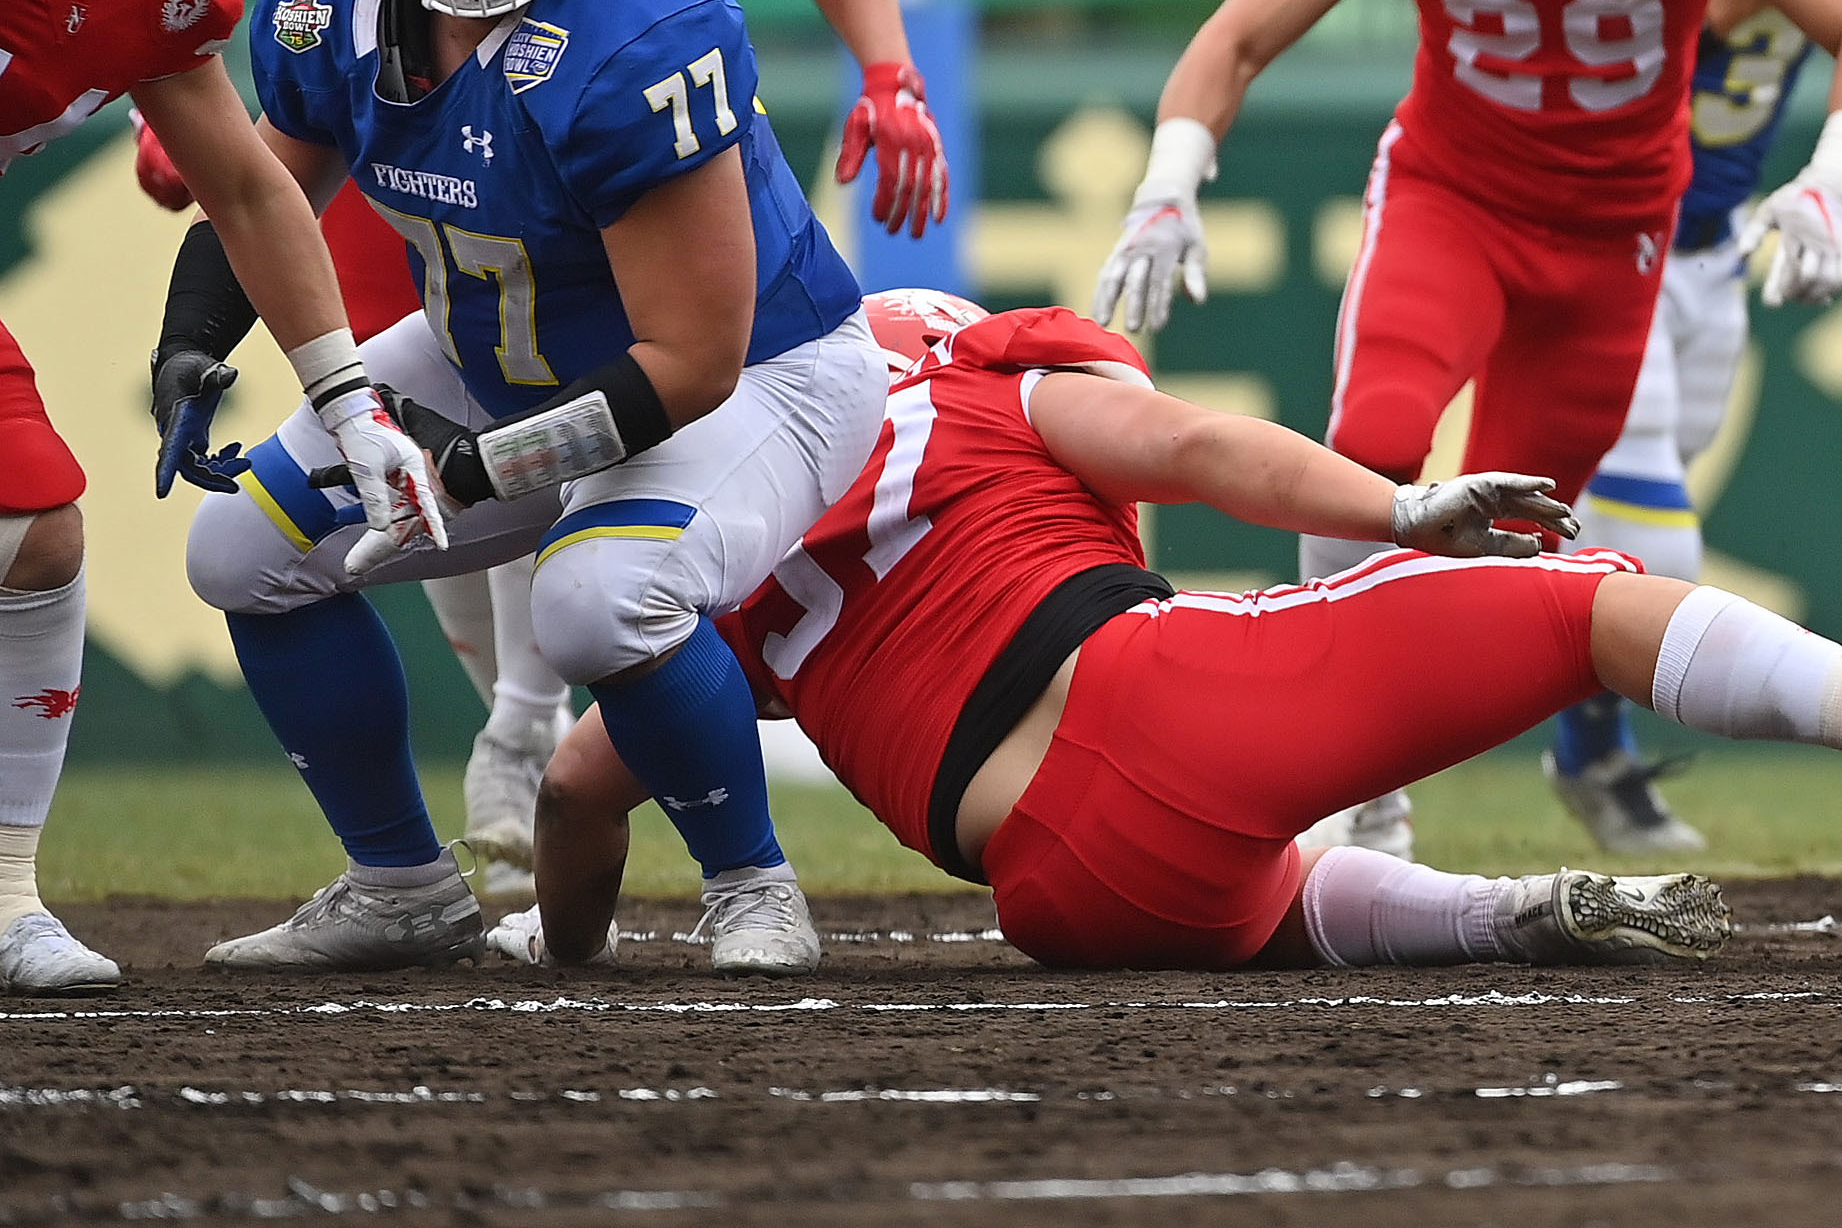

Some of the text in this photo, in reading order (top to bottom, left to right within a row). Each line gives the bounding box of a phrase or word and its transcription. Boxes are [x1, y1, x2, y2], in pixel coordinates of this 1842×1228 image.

[275, 6, 328, 25] KOSHIEN
[282, 20, 312, 32] BOWL
[290, 35, 303, 45] 75
[643, 50, 738, 160] 77
[370, 163, 478, 208] FIGHTERS
[361, 190, 560, 386] 77
